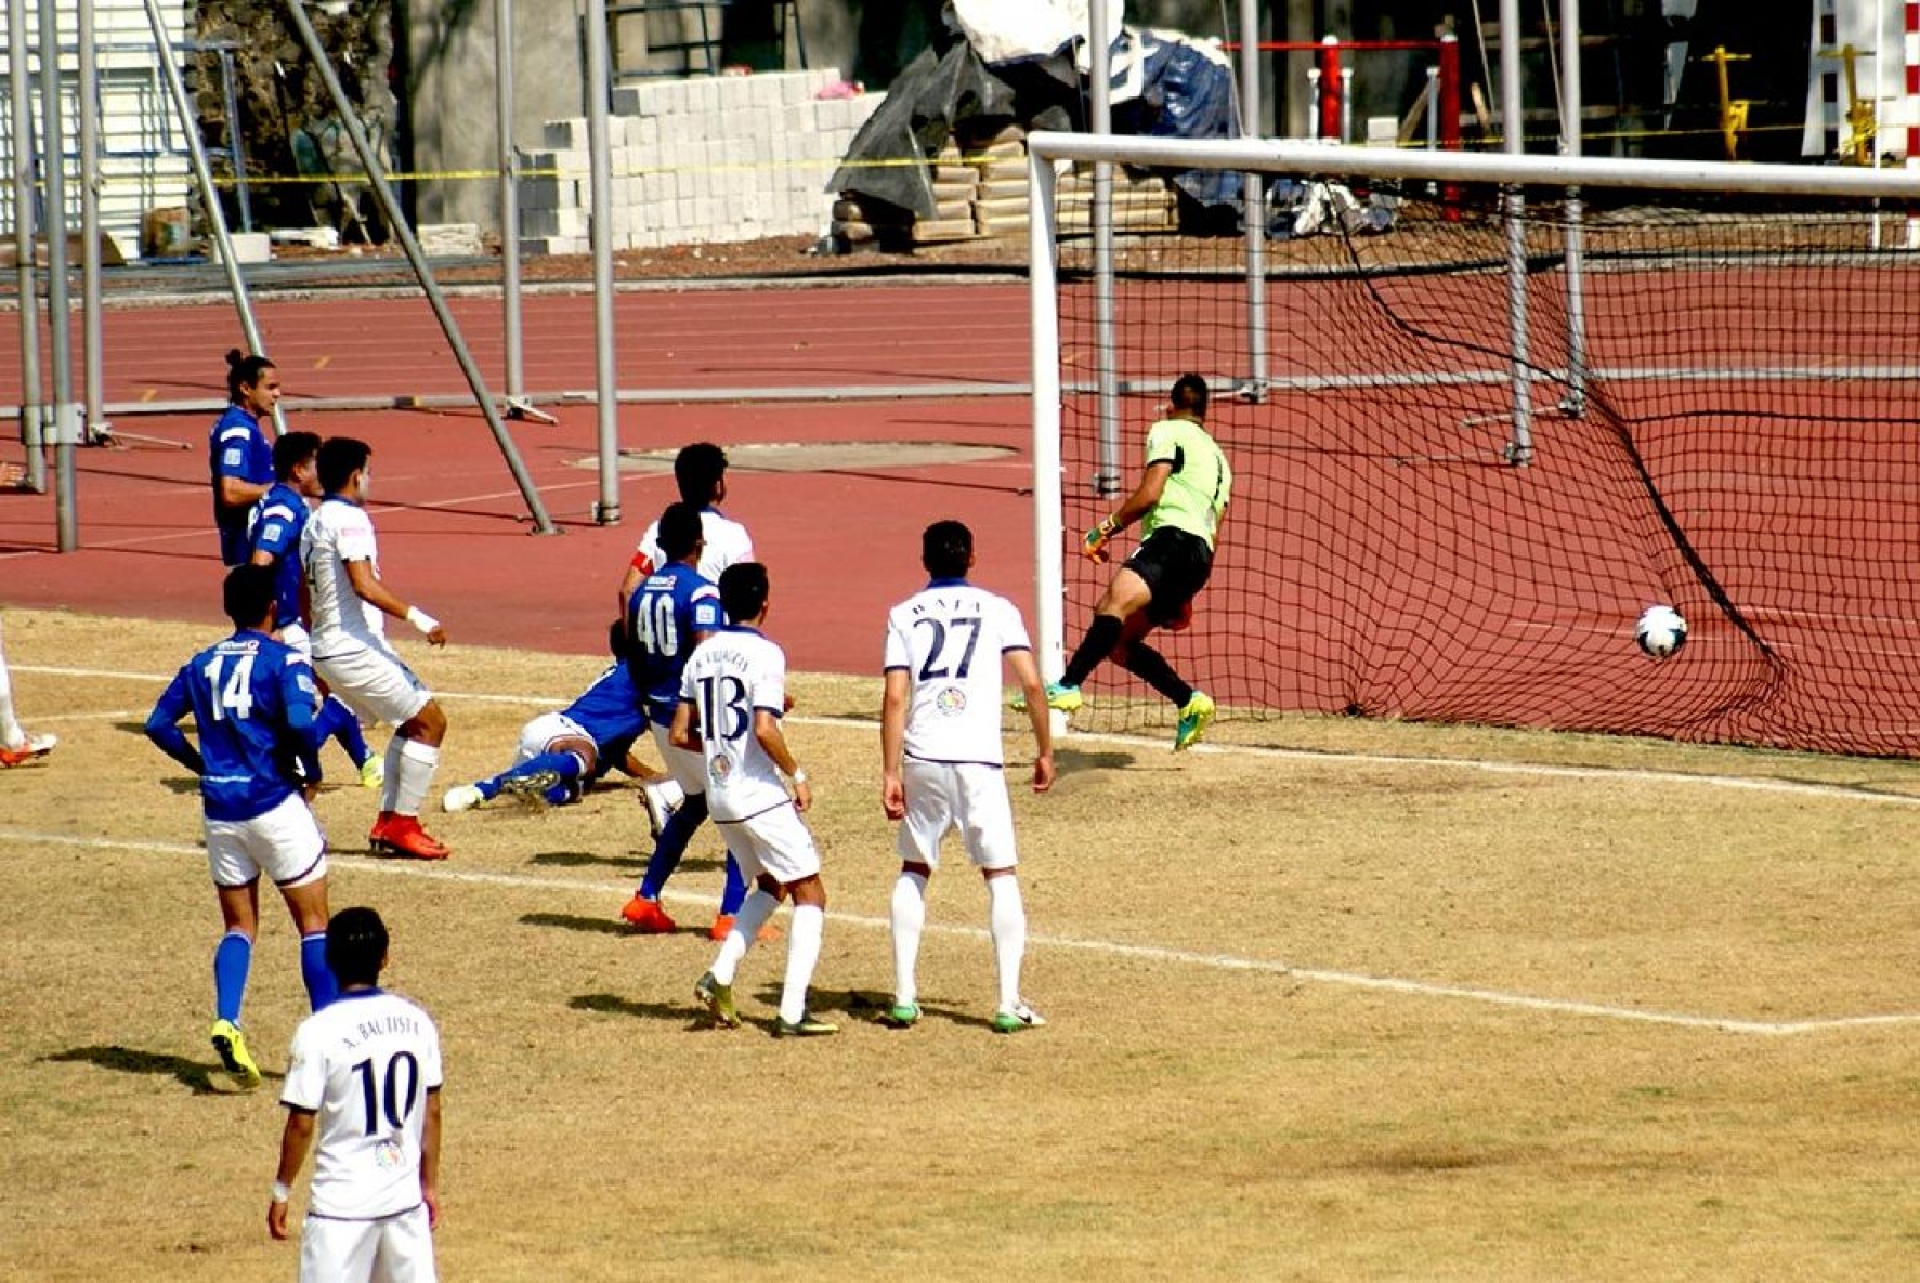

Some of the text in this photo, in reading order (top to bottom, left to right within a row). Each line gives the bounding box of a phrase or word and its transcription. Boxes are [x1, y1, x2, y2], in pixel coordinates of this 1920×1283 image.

[637, 593, 678, 656] 40
[913, 617, 982, 681] 27
[204, 655, 254, 721] 14
[697, 676, 749, 741] 13
[351, 1050, 419, 1137] 10
